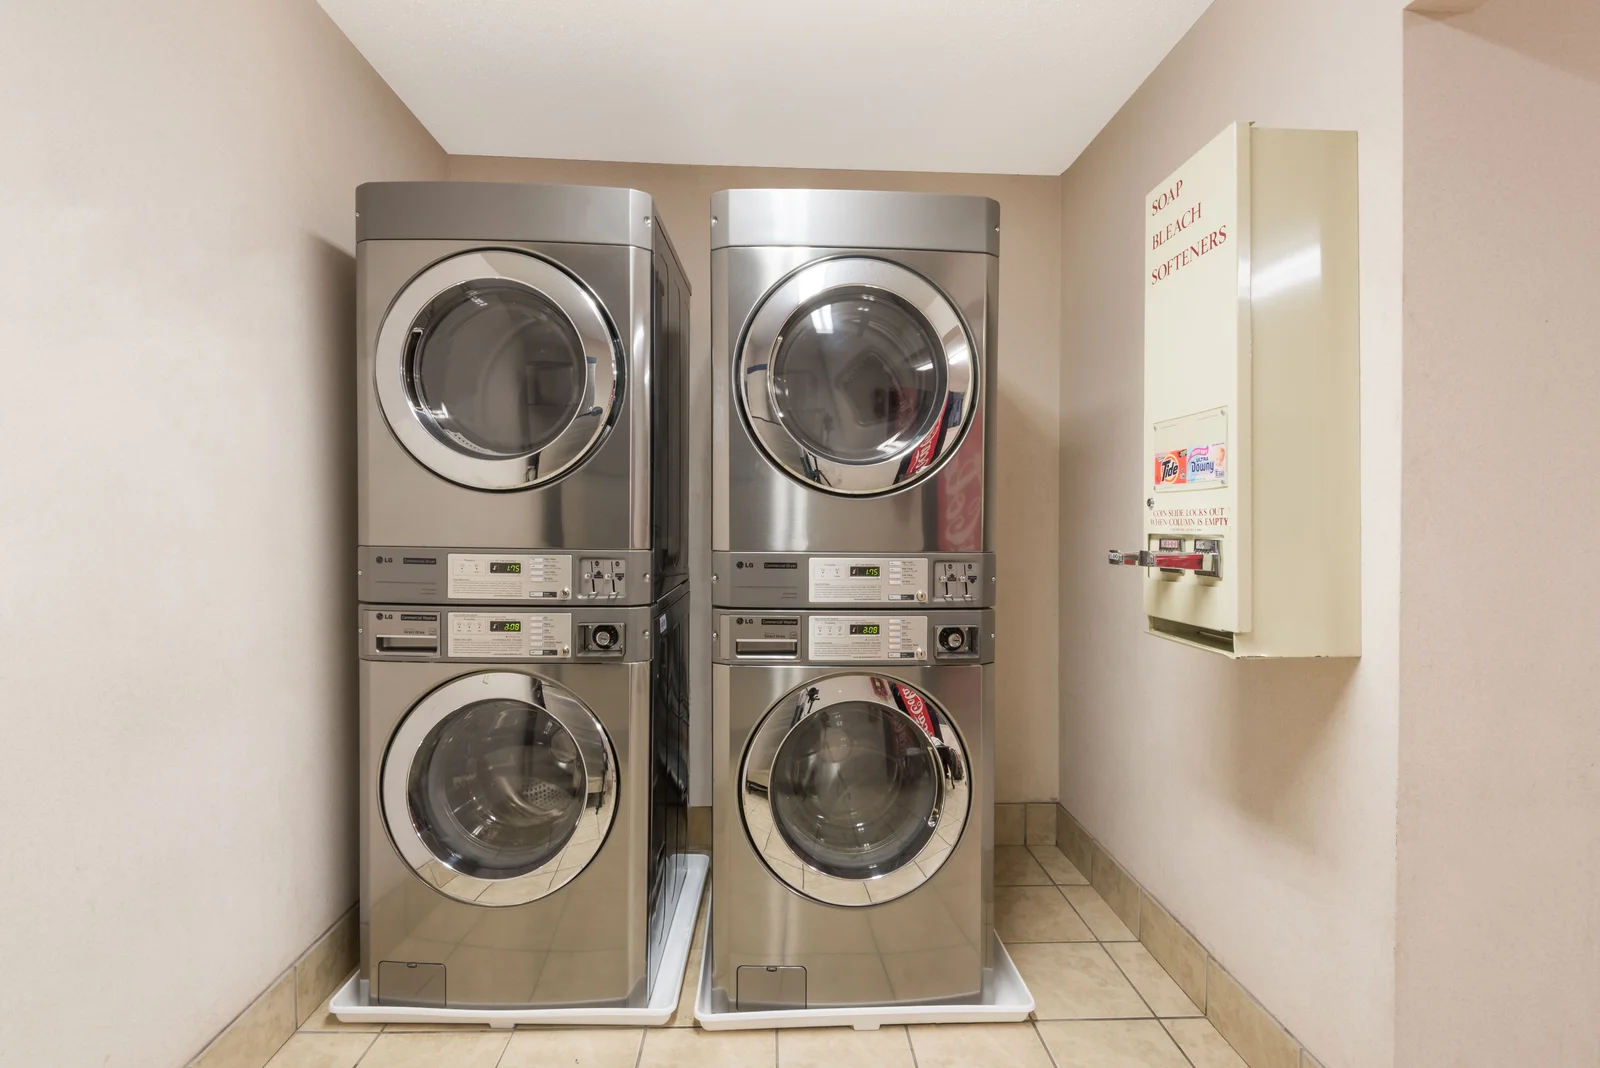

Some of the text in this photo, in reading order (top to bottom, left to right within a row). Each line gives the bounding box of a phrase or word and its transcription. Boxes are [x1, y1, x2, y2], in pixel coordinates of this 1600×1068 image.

[1151, 179, 1184, 217] SOAP
[1152, 201, 1202, 251] BLEACH
[1151, 224, 1227, 286] SOFTENERS
[1161, 458, 1179, 482] Tide
[1190, 461, 1215, 474] Downy
[1150, 517, 1229, 526] WHEN COLUMN IS EMPTY
[1168, 509, 1184, 517] SLIDE
[1185, 508, 1208, 517] LOCKS
[1209, 507, 1225, 516] OUT
